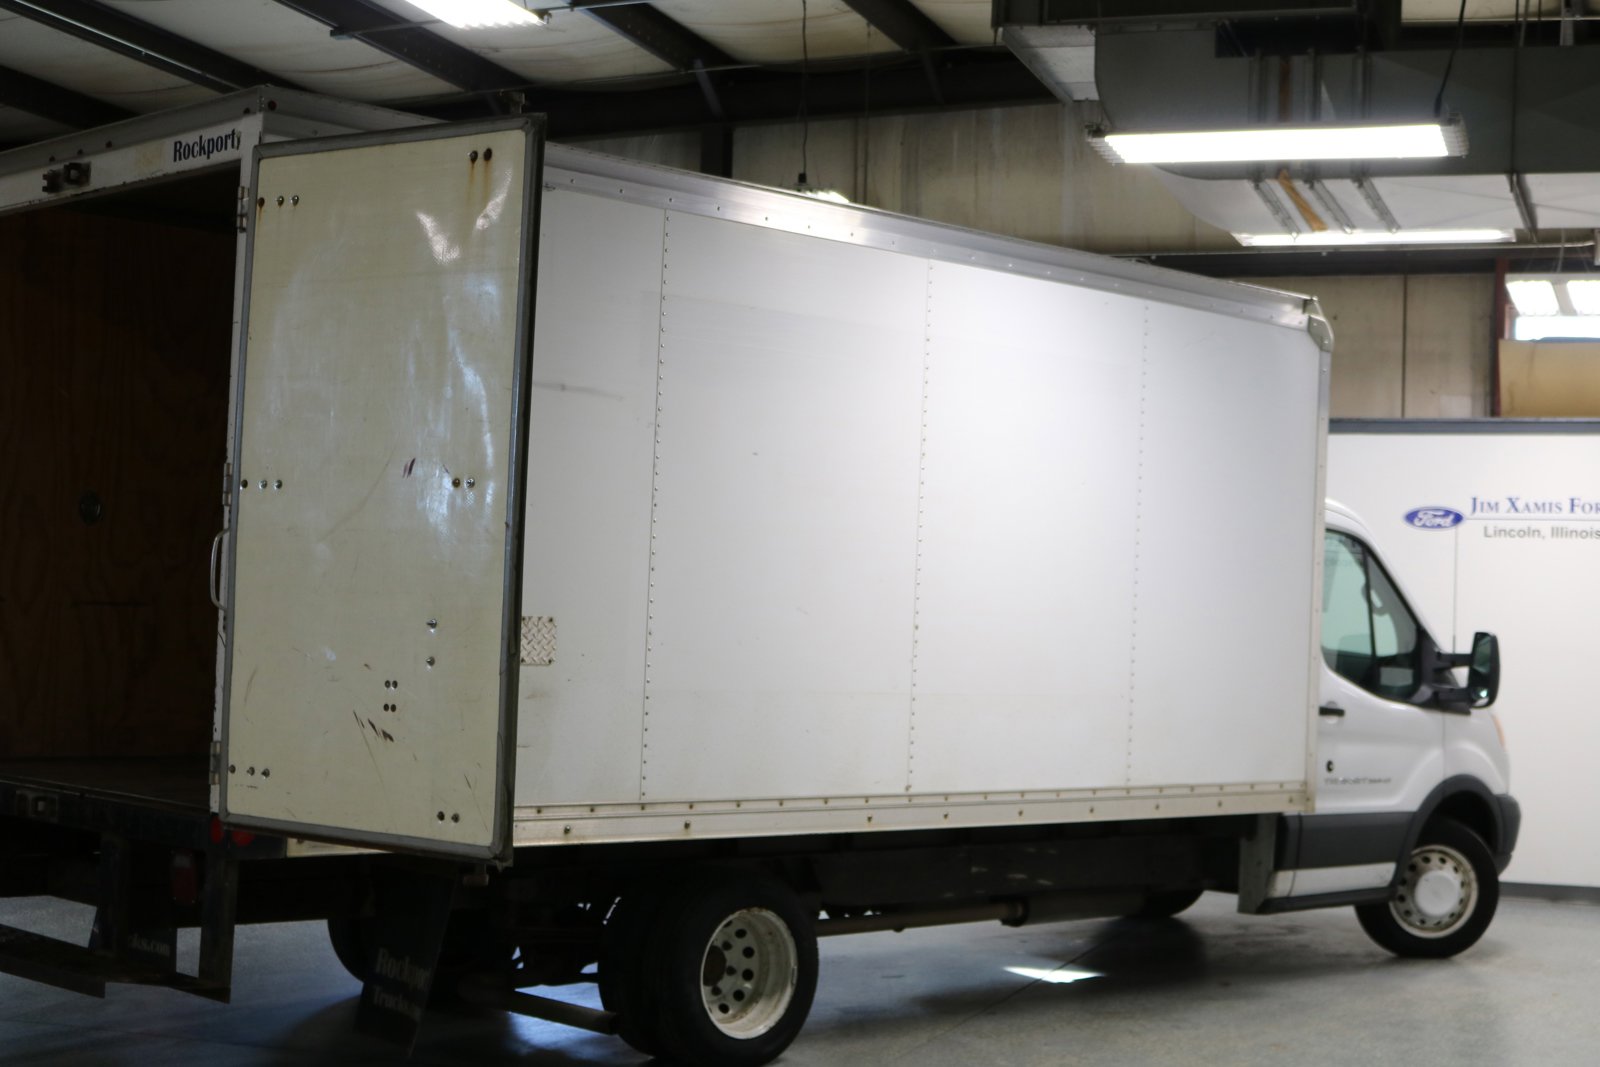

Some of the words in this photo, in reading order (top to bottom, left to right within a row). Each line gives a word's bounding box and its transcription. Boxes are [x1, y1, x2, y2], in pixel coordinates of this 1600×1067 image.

[173, 128, 236, 162] Rockport
[1471, 496, 1499, 515] JIM
[1506, 497, 1563, 514] XAMIS
[1411, 508, 1457, 529] Ford
[1483, 525, 1546, 540] Lincoln,
[1550, 526, 1600, 540] Illinois
